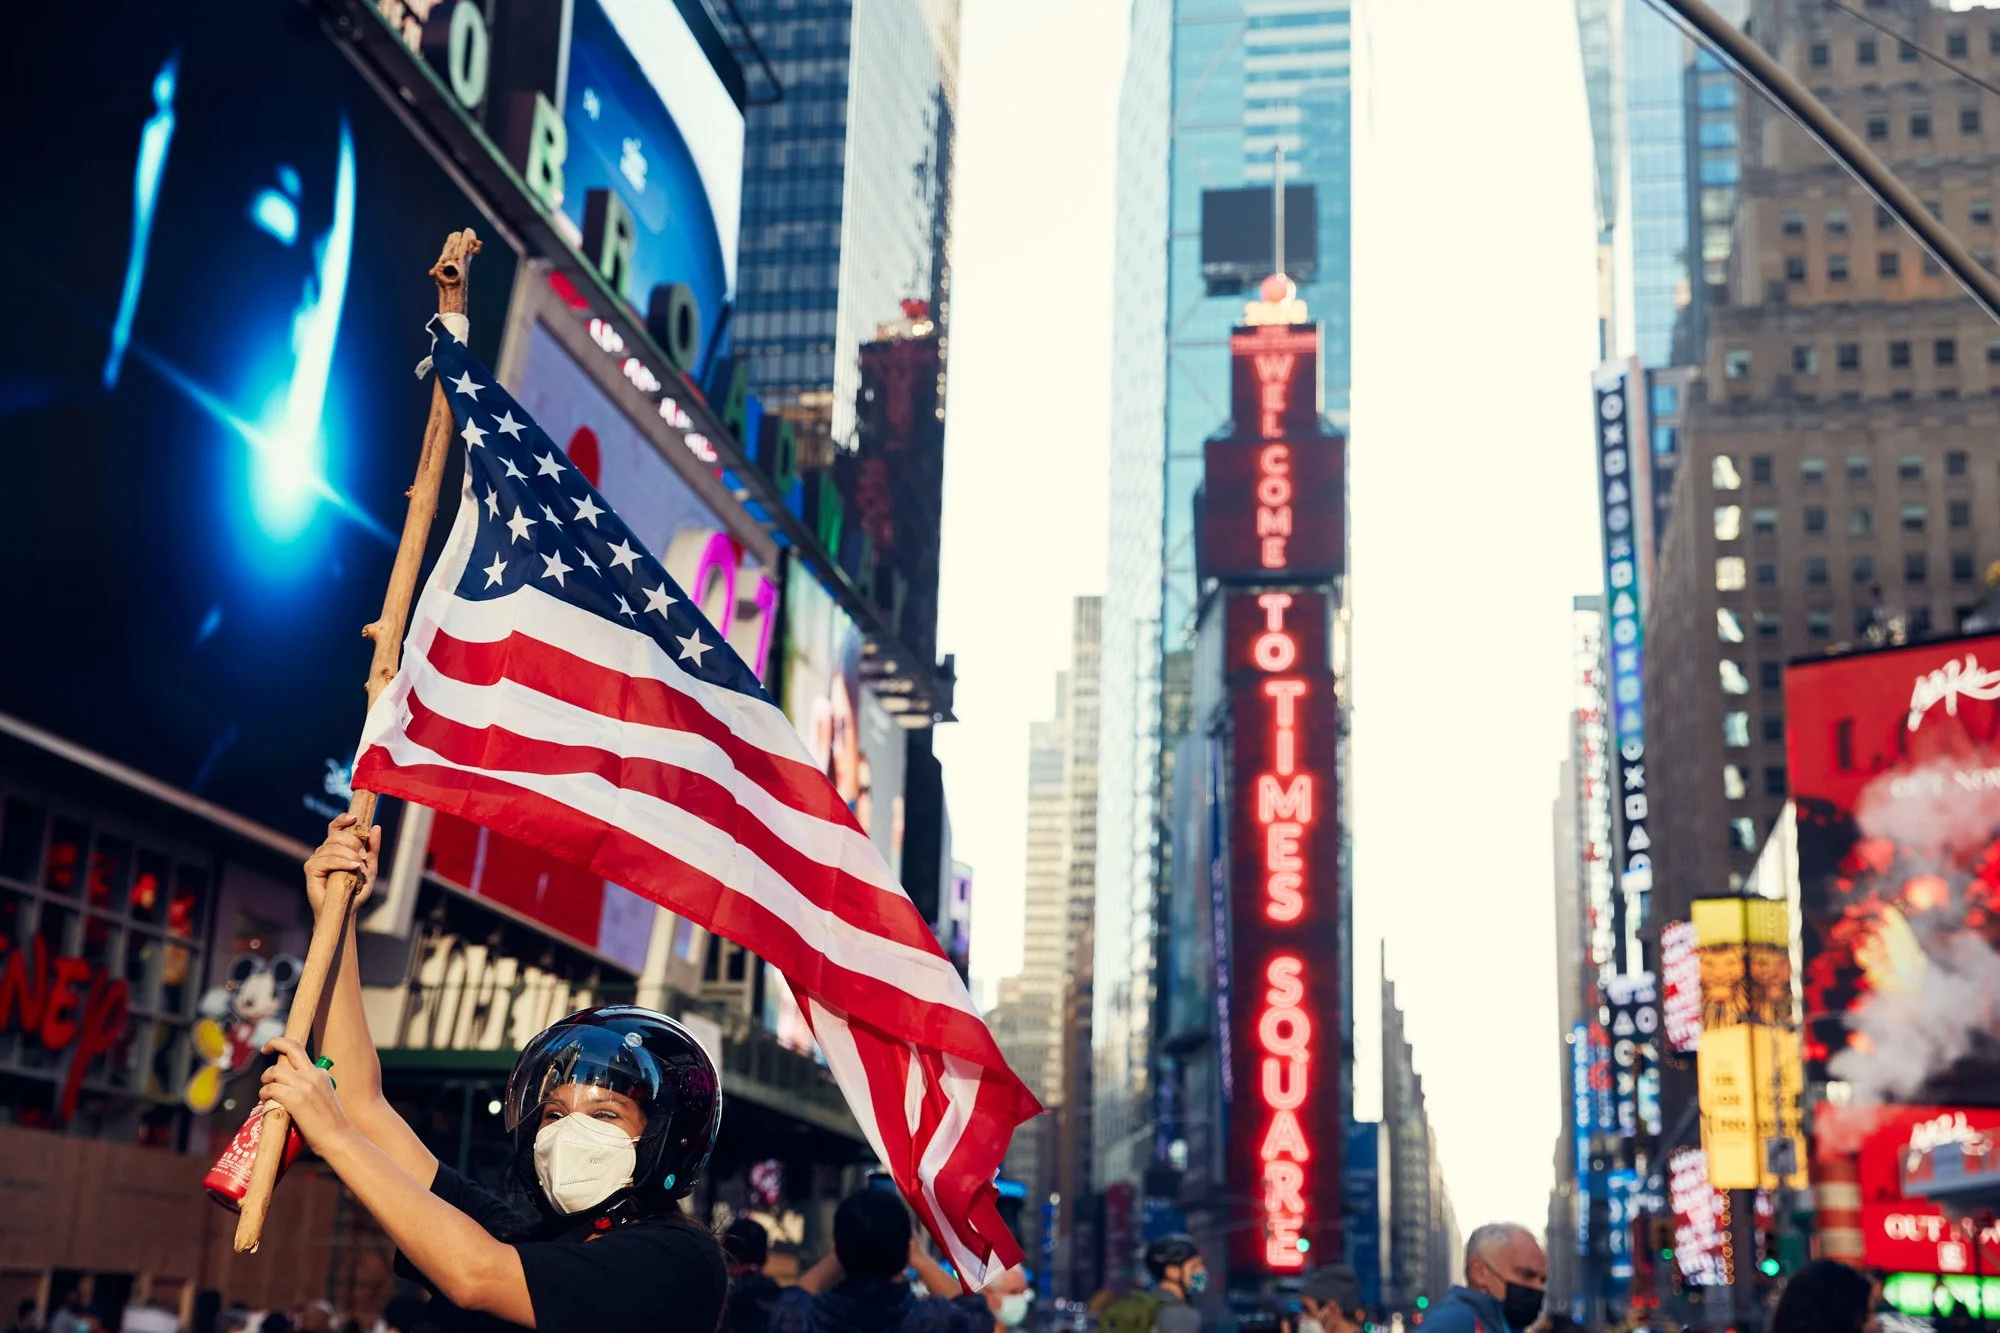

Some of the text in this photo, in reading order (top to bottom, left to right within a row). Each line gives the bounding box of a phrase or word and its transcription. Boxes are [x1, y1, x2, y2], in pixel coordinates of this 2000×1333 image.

[1254, 353, 1313, 1267] WELCOME TO TIMES SQUARE
[1883, 1212, 1947, 1242] OUT
